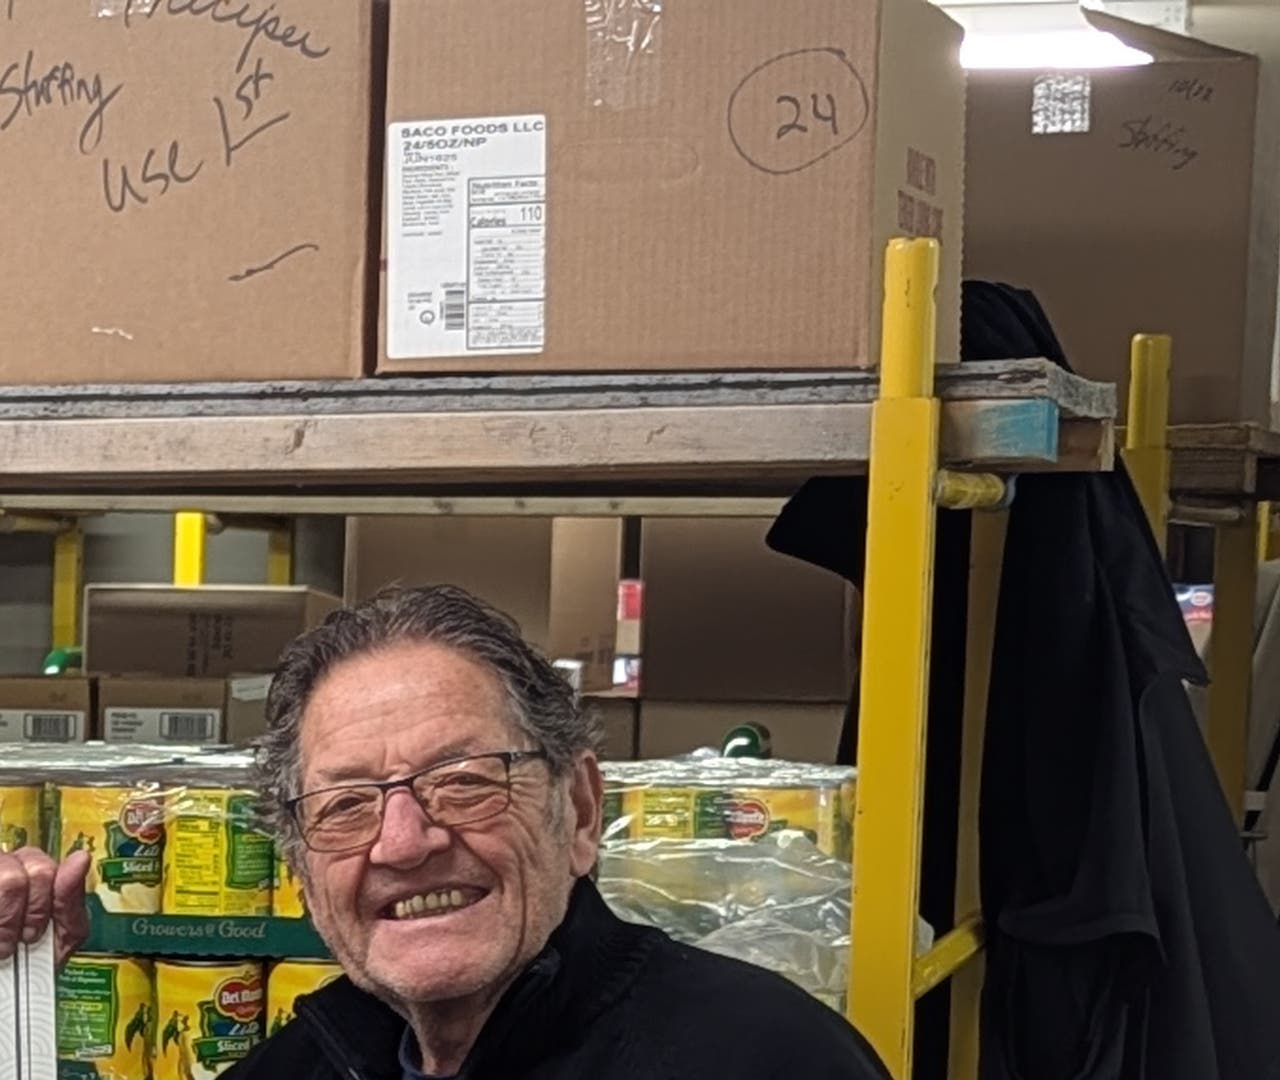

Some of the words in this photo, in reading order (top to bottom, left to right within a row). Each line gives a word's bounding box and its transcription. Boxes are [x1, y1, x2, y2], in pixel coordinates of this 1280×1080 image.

[777, 93, 839, 140] 24
[401, 128, 447, 138] SACO
[451, 123, 509, 135] FOODS
[513, 121, 545, 133] LLC
[520, 206, 542, 221] 110
[218, 919, 267, 938] Good
